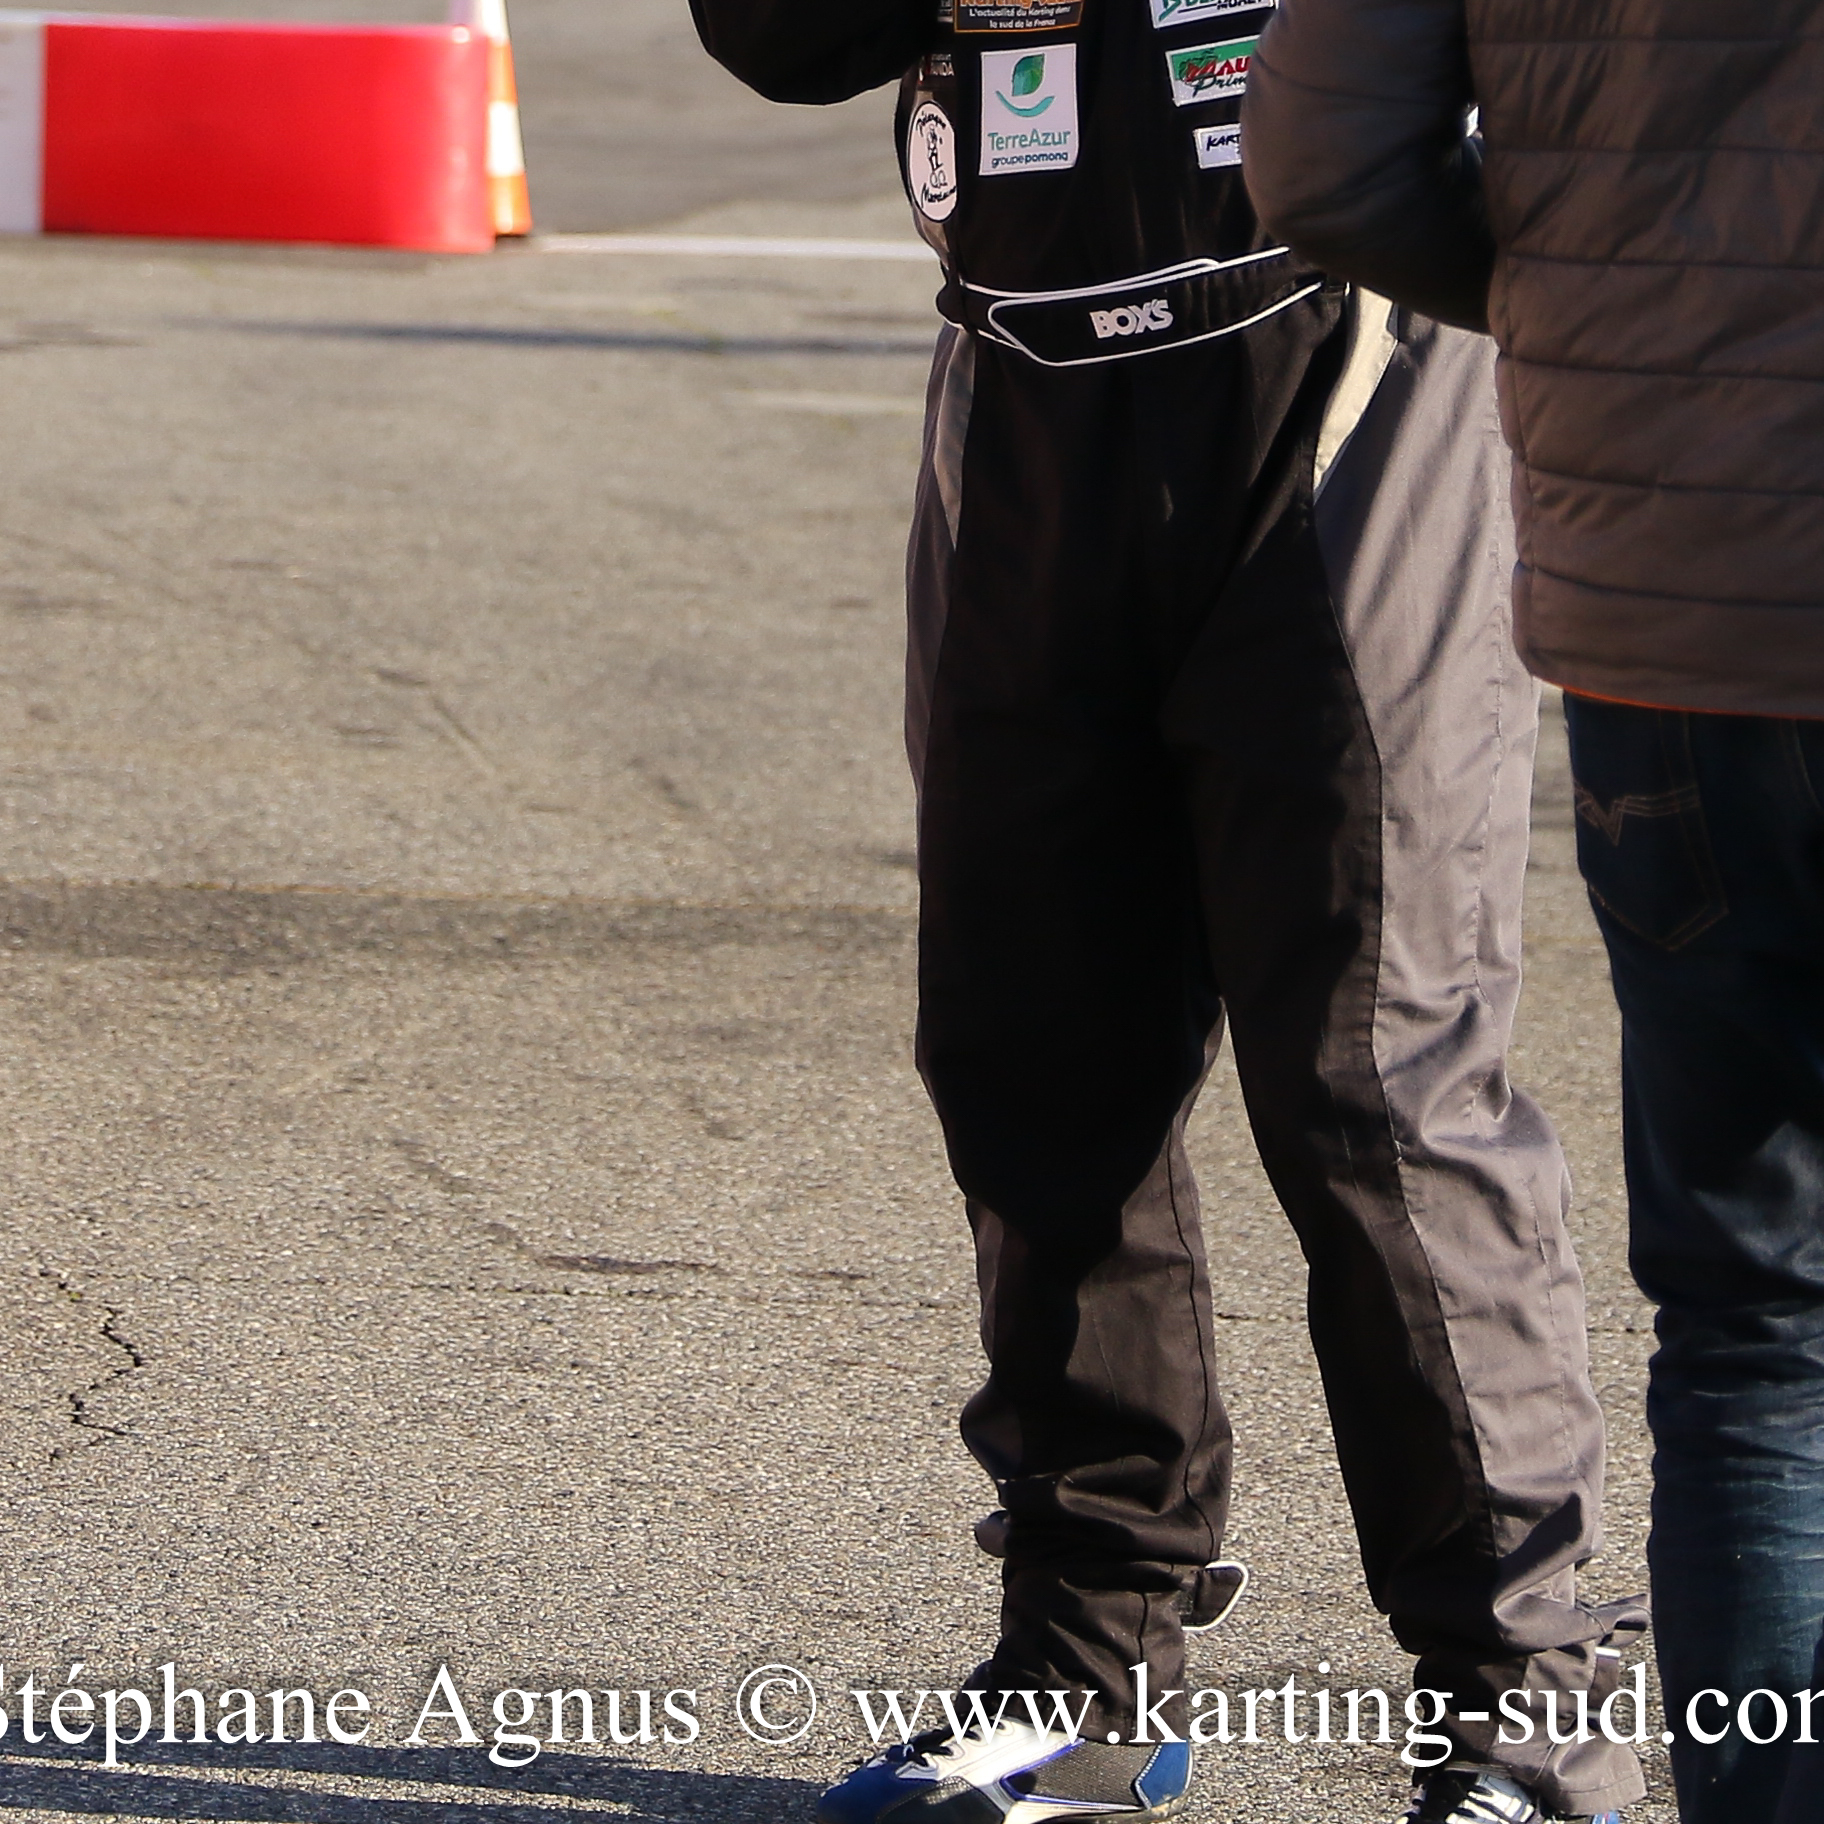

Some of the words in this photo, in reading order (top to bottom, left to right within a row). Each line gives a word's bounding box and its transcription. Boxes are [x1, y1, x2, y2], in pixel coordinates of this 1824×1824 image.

[1016, 8, 1026, 17] du
[999, 19, 1013, 28] sud
[1015, 19, 1024, 28] de
[987, 128, 1071, 151] TerreAzur
